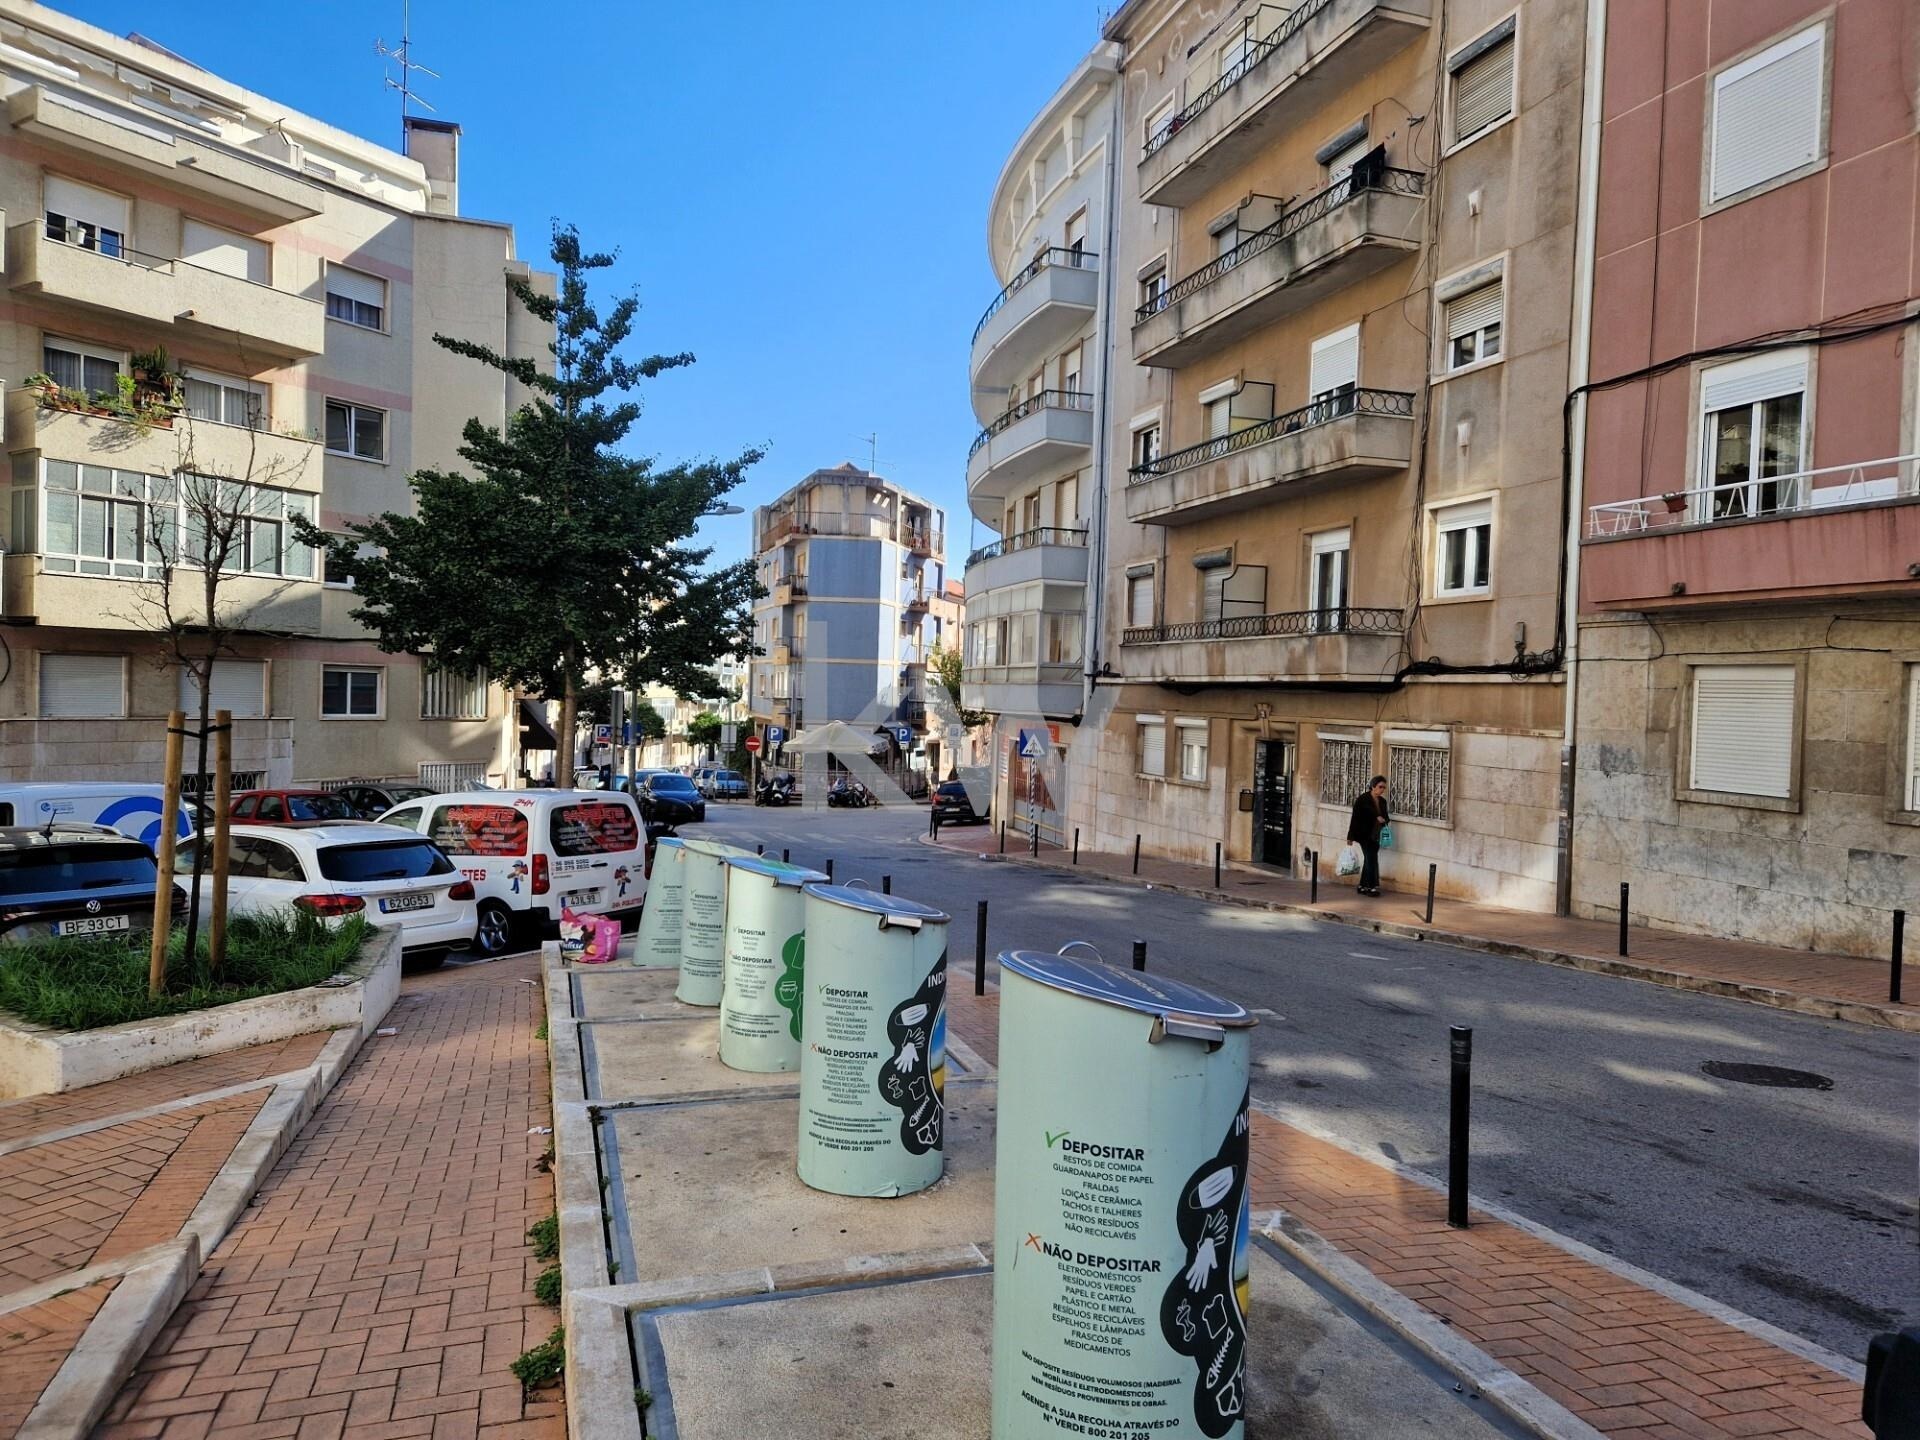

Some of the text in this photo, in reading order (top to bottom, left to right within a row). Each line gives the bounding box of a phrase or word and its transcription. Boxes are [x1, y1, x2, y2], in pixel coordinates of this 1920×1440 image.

[770, 728, 780, 740] P
[899, 728, 908, 740] P
[826, 988, 868, 998] DEPOSITAR
[818, 1046, 878, 1059] NÃO DEPOSITAR
[1062, 1139, 1144, 1160] DEPOSITAR
[1063, 1155, 1143, 1172] RESTOS DE COMIDA
[1052, 1163, 1114, 1181] GUARDANAPOS
[1129, 1176, 1154, 1184] PAPEL
[1082, 1181, 1119, 1193] FRALDAS
[1062, 1188, 1142, 1206] LOIÇAS E CERÂMICA
[1061, 1199, 1093, 1212] TACHOS
[1101, 1206, 1142, 1217] TALHERES
[1063, 1211, 1139, 1229] OUTROS RESÍDUOS
[1065, 1222, 1083, 1233] NÃO
[1043, 1242, 1161, 1272] NÃO DEPOSITAR
[1058, 1262, 1142, 1283] ELETRODOMÉSTICOS
[1062, 1274, 1135, 1293] RESÍDUOS VERDES
[1065, 1286, 1089, 1298] PAPEL
[1097, 1292, 1132, 1303] CARTÃO
[1053, 1303, 1092, 1320] RESÍDUOS
[1062, 1296, 1135, 1314] PLÁSTICO E METAL
[1052, 1313, 1145, 1336] ESPELHOS E LÂMPADAS
[1072, 1330, 1123, 1345] FRASCOS DE
[1064, 1338, 1131, 1357] MEDICAMENTOS
[1022, 1350, 1033, 1361] NÃO
[1033, 1357, 1060, 1373] DEPOSITE
[1062, 1367, 1095, 1383] RESÍDUOS
[1096, 1378, 1142, 1388] VOLUMOSOS
[1042, 1371, 1072, 1387] MOBÍLIAS
[1031, 1375, 1044, 1386] NEM
[1044, 1382, 1076, 1398] RESÍDUOS
[1077, 1393, 1129, 1407] PROVENIENTES
[1021, 1390, 1180, 1430] AGENDE A SUA RECOLHA ATRAVÉS DO
[1054, 1417, 1085, 1434] VERDE
[1088, 1427, 1107, 1438] 800
[1109, 1430, 1127, 1440] 201
